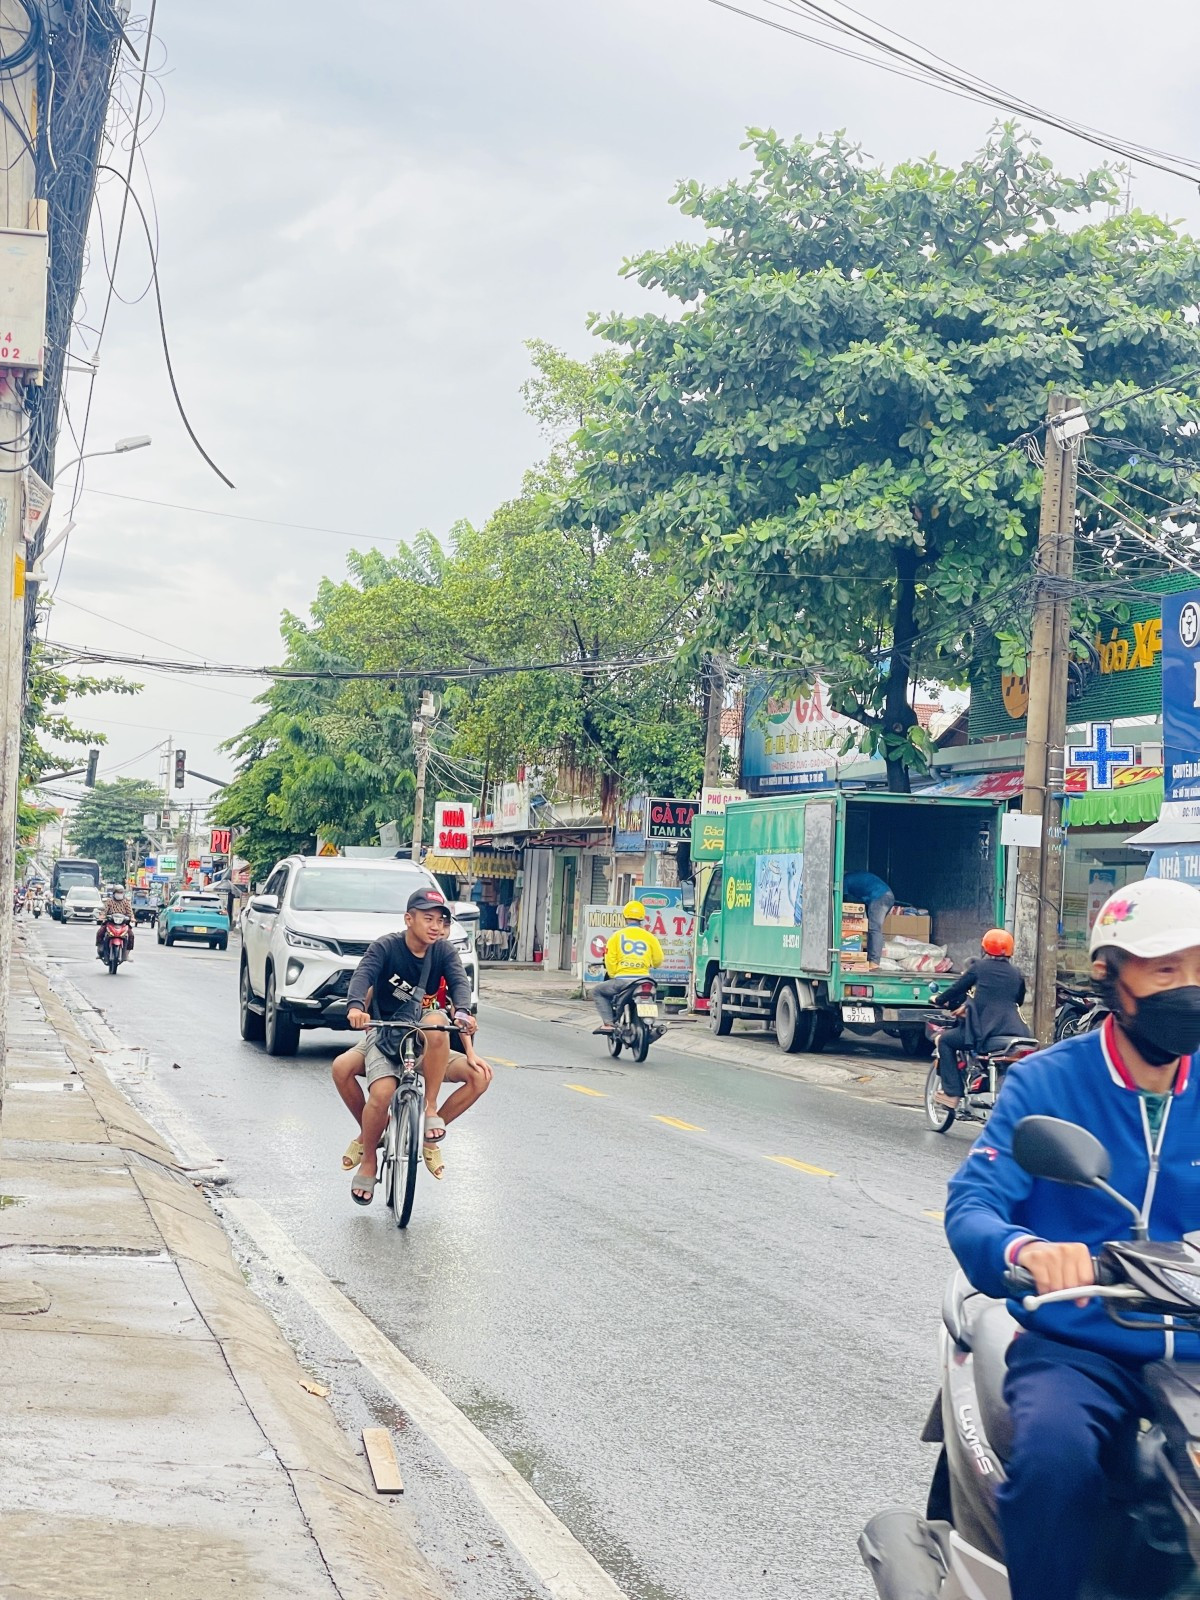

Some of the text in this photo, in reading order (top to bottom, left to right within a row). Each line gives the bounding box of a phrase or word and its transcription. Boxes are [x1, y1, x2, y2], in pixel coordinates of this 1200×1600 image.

[443, 807, 465, 827] NHÀ
[651, 802, 674, 825] GÀ
[439, 829, 468, 850] SÁCH
[652, 825, 676, 837] TAM
[1159, 852, 1200, 879] NHÀ TH
[601, 907, 626, 928] QUẢN
[620, 934, 648, 956] be
[847, 1014, 871, 1022] 927.41
[851, 1007, 866, 1015] 51L
